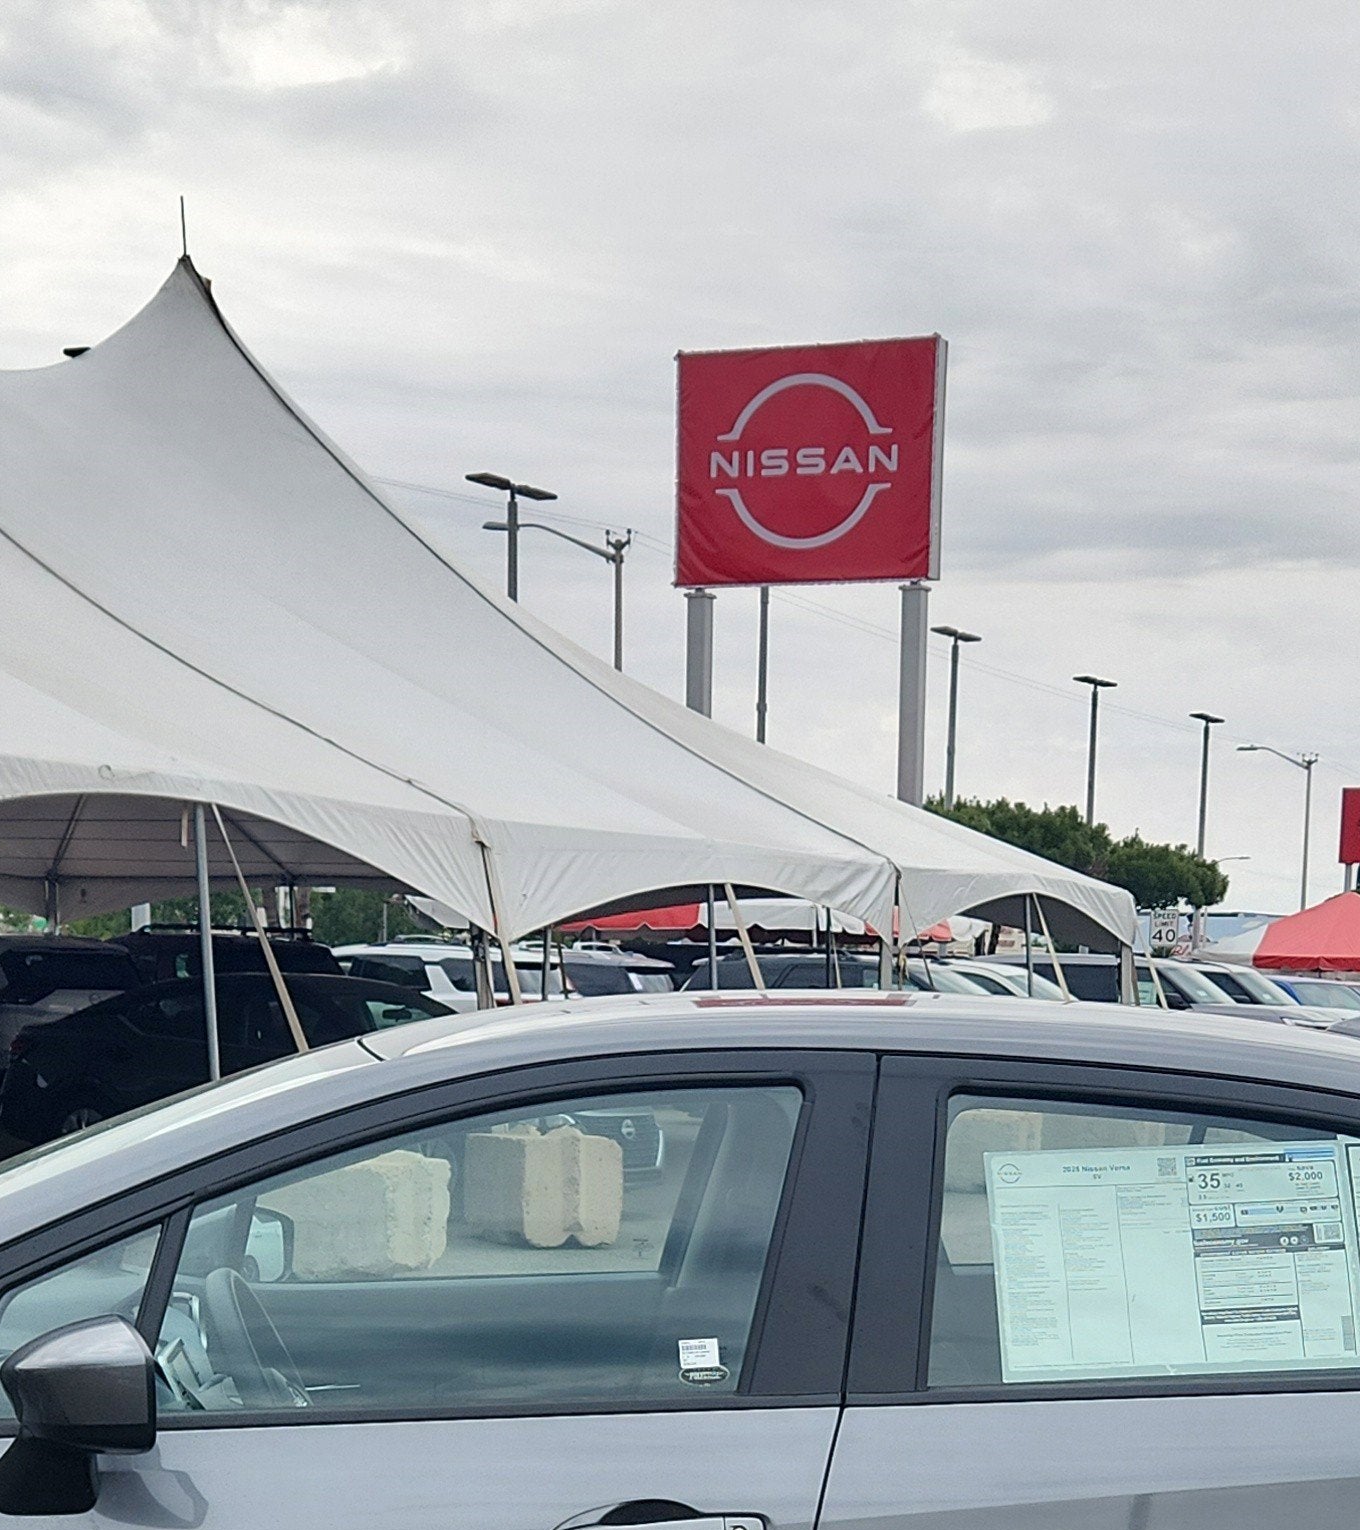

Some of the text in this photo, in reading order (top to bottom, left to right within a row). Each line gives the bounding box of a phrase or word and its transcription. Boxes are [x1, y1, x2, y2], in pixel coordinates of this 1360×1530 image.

[709, 443, 899, 478] NISSAN
[1152, 912, 1177, 920] SPEED
[1152, 929, 1176, 942] 40
[1198, 1172, 1221, 1190] 35
[1196, 1211, 1231, 1223] $1,500
